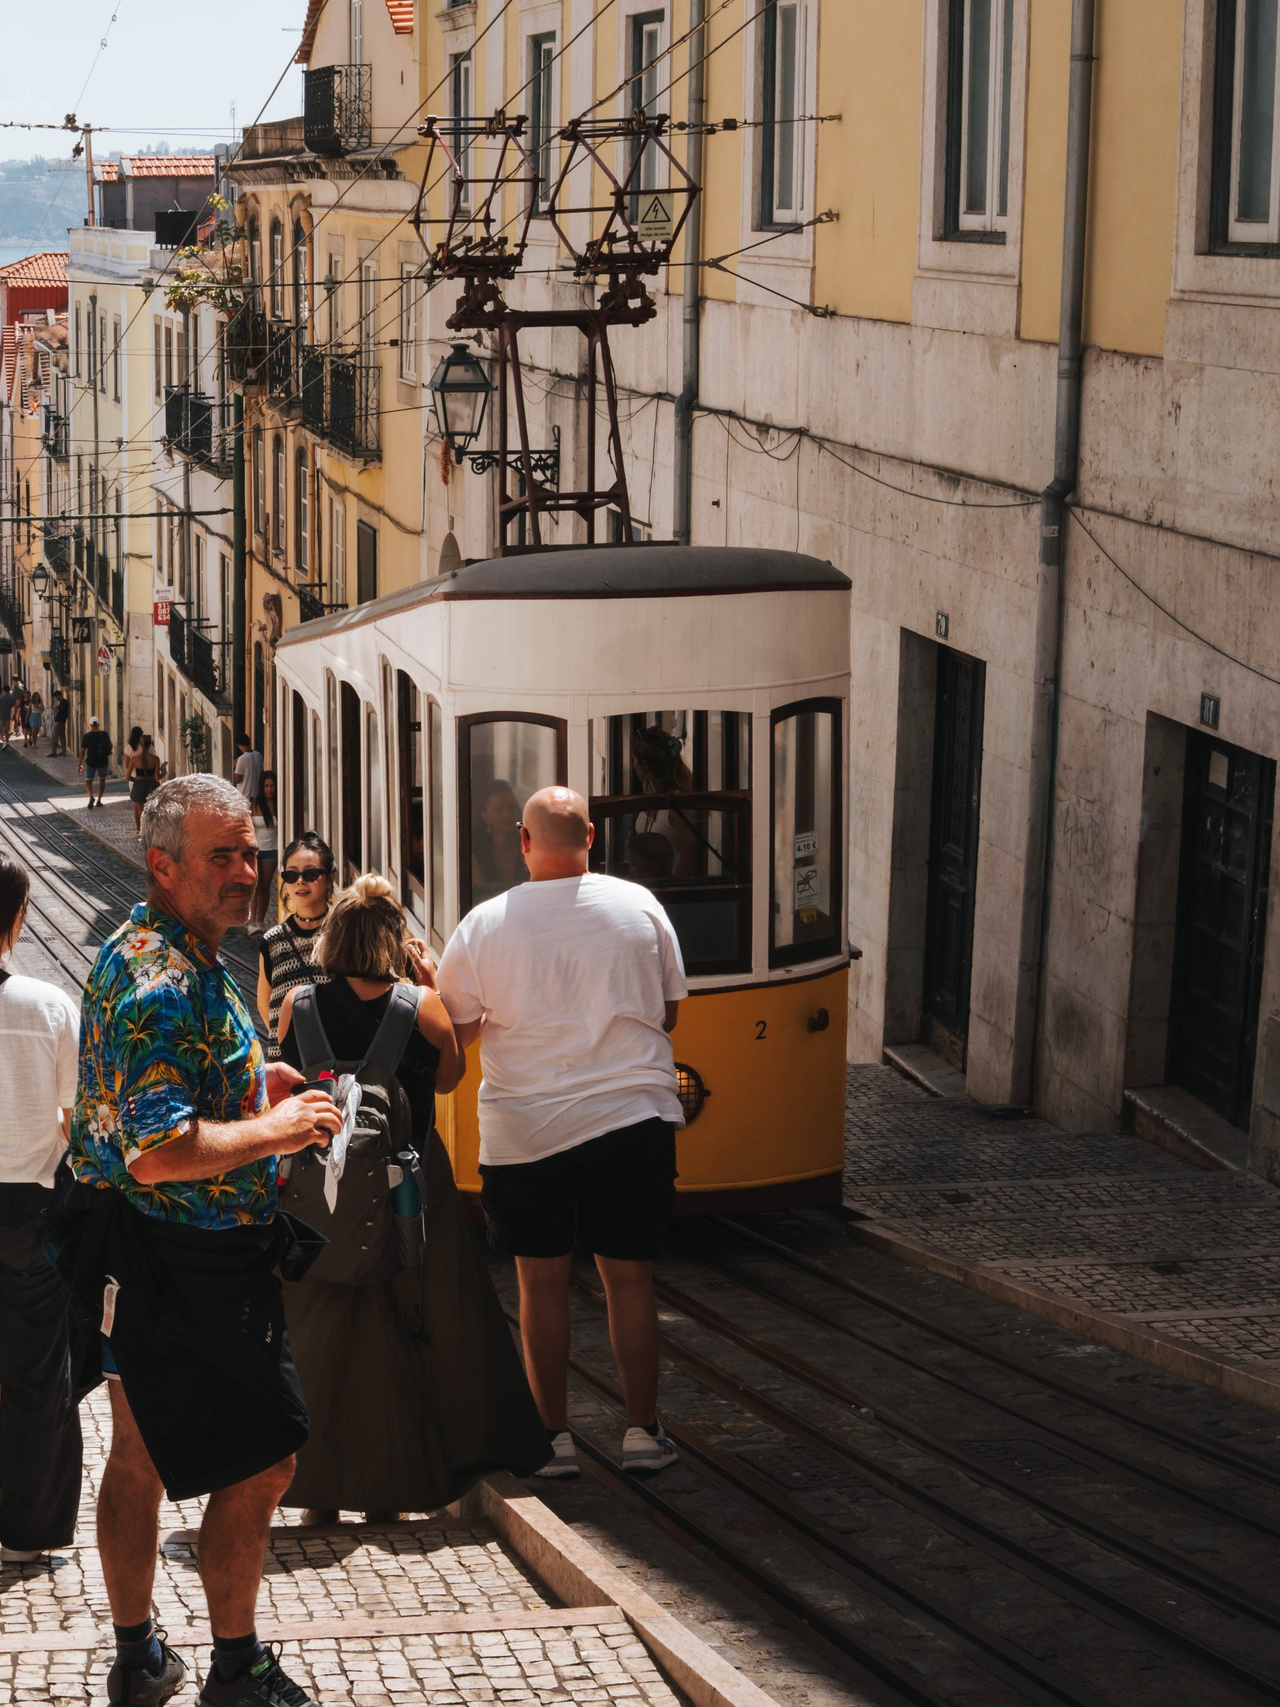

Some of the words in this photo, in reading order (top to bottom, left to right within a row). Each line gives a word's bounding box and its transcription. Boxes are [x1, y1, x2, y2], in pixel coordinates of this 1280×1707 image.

[937, 614, 946, 636] 79
[1203, 698, 1215, 724] 81
[796, 842, 811, 852] 4.10
[755, 1020, 767, 1040] 2
